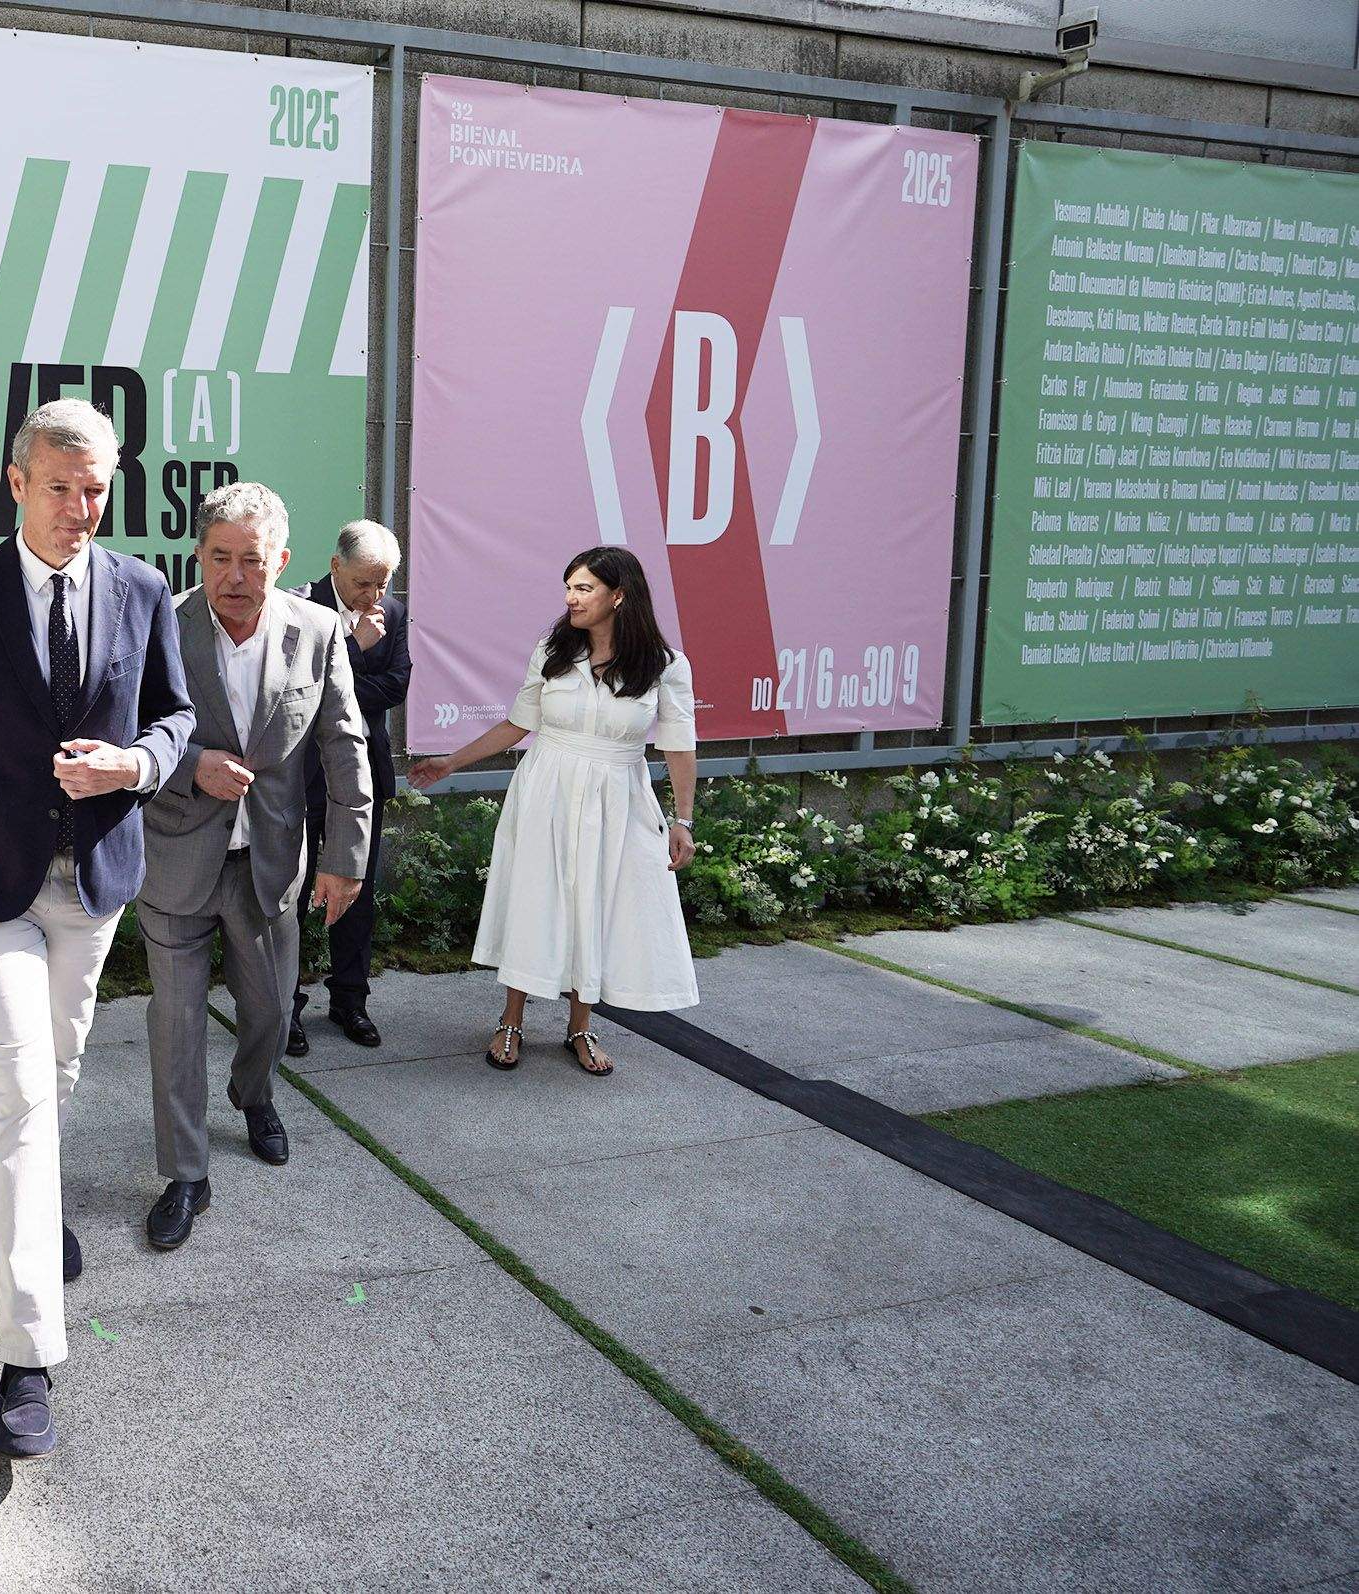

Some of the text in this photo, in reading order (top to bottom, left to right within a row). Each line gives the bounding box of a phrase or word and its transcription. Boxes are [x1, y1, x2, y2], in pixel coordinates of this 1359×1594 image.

[269, 85, 339, 151] 2025
[451, 101, 474, 121] 32
[450, 123, 523, 148] BIENAL
[449, 145, 584, 176] PONTEVEDRA
[901, 149, 952, 207] 2025
[1054, 200, 1091, 223] Yasmeen
[1094, 203, 1129, 227] Abdullah
[1201, 212, 1219, 234] Pilar
[1050, 235, 1083, 258] Antonio
[1085, 237, 1121, 260] Ballester
[1124, 240, 1154, 263] Moreno
[1234, 249, 1259, 271] Carlos
[1048, 269, 1076, 293] Centro
[1078, 272, 1127, 296] Documental
[1141, 276, 1175, 299] Memoria
[1046, 304, 1094, 331] Deschamps,
[1097, 308, 1114, 329] Kati
[1116, 308, 1141, 333] Horna,
[1143, 310, 1169, 332] Walter
[1043, 339, 1073, 361] Andrea
[1101, 343, 1124, 364] Rubio
[1041, 374, 1068, 396] Carlos
[1073, 376, 1087, 397] Fer
[1103, 377, 1143, 399] Almudena
[1149, 379, 1189, 401] Fernández
[1038, 408, 1078, 431] Francisco
[1082, 409, 1093, 431] de
[1096, 410, 1117, 435] Goya
[1131, 411, 1153, 437] Wang
[1094, 444, 1117, 469] Emily
[1034, 477, 1052, 498] Miki
[1054, 477, 1072, 498] Leal
[1031, 510, 1062, 532] Paloma
[1029, 544, 1061, 565] Soledad
[1100, 544, 1124, 565] Susan
[1026, 577, 1068, 602] Dagoberto
[1075, 577, 1114, 601] Rodríguez
[1134, 576, 1161, 597] Beatriz
[1021, 643, 1052, 666] Damián
[751, 641, 920, 720] DO 21/6 AO 30/9
